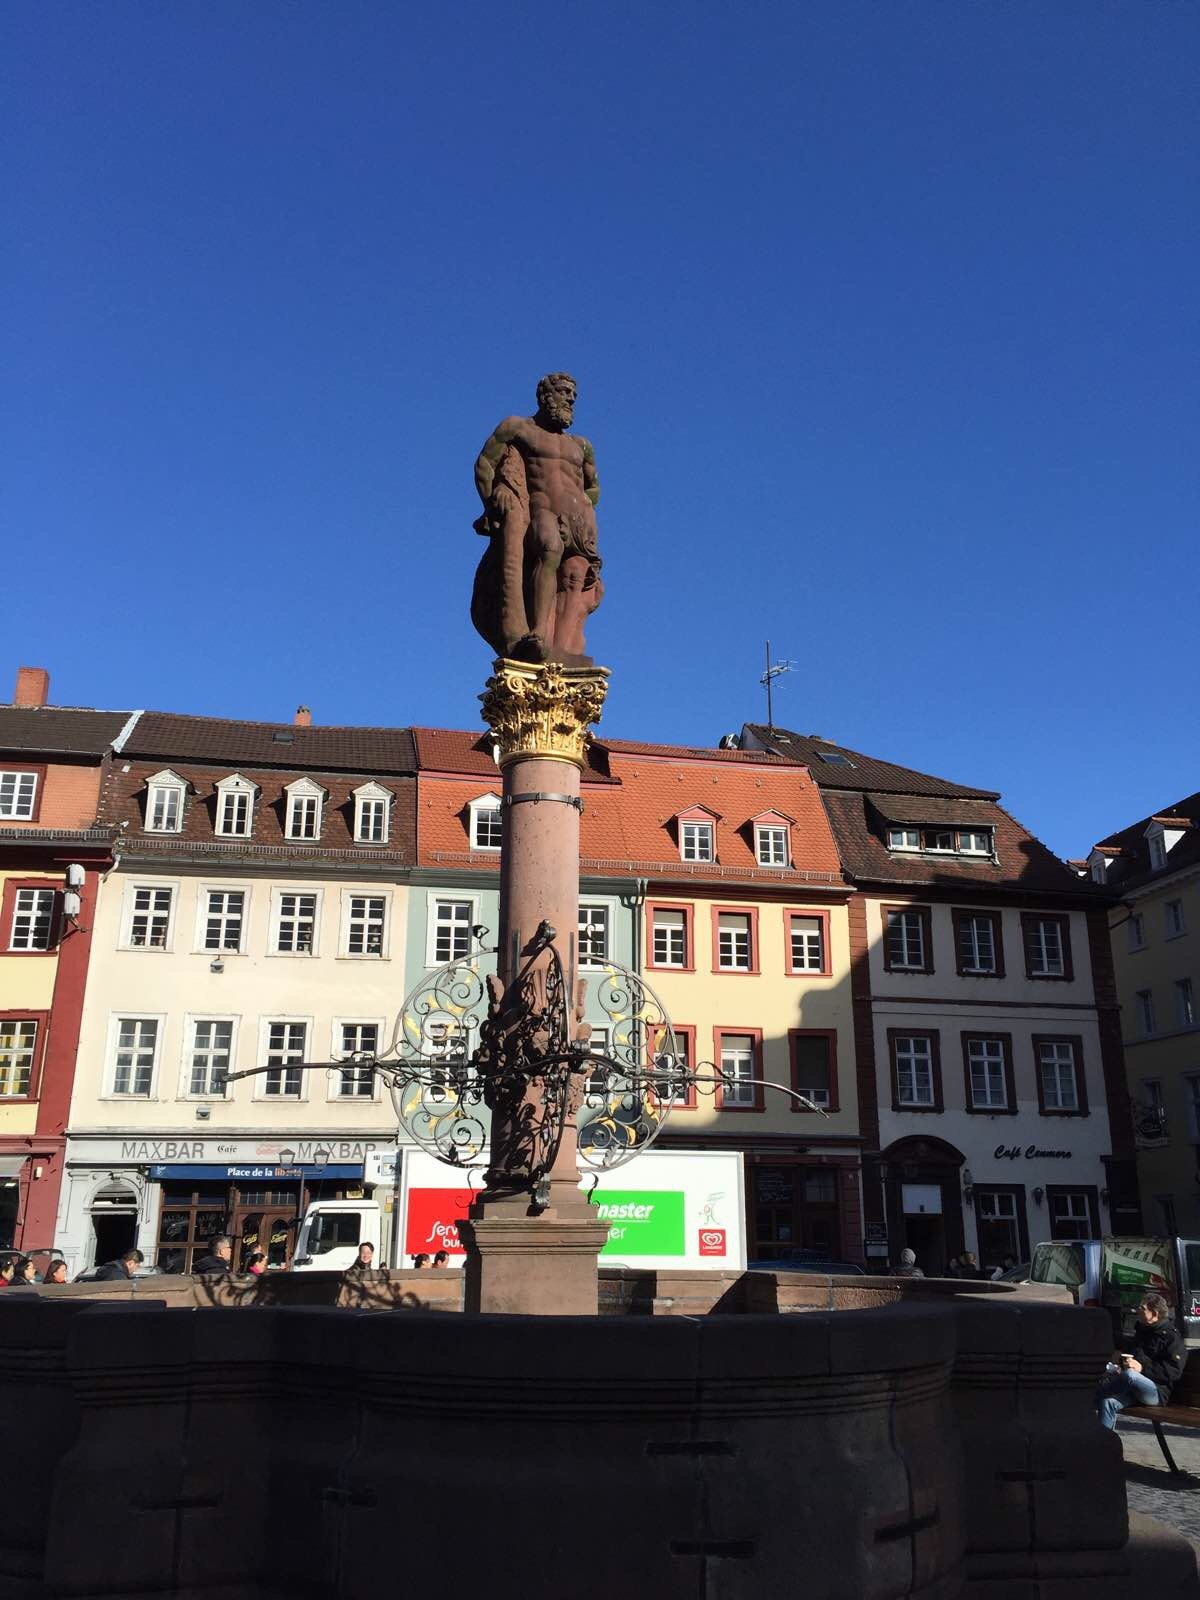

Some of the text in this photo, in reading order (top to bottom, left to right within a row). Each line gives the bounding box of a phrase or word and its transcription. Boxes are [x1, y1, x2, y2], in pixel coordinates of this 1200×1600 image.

[227, 1167, 250, 1177] Place
[252, 1167, 263, 1177] de
[264, 1167, 273, 1177] la
